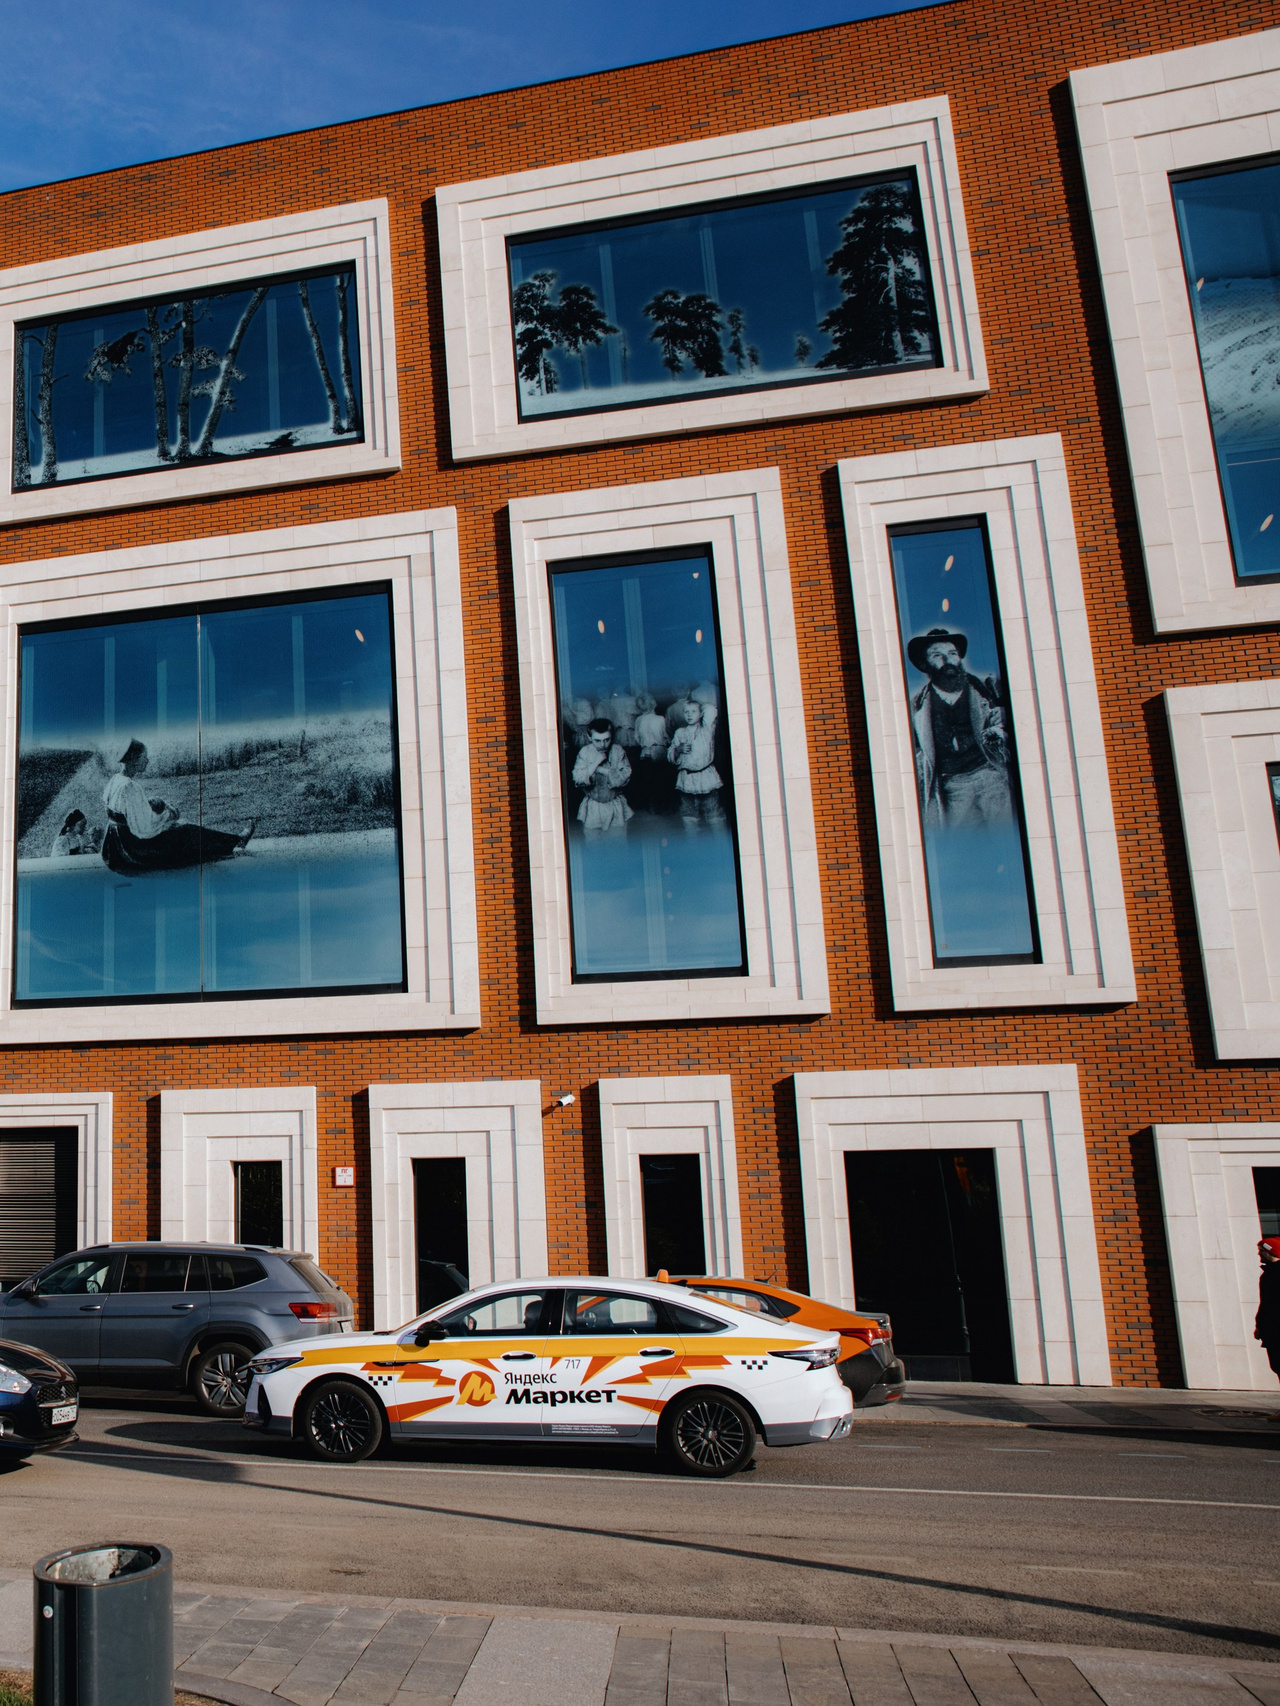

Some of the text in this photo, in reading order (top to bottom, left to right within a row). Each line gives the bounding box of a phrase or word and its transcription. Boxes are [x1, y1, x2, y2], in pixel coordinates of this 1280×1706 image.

[564, 1359, 581, 1370] 717
[504, 1372, 558, 1386] Яндекс
[505, 1388, 617, 1407] Маркет
